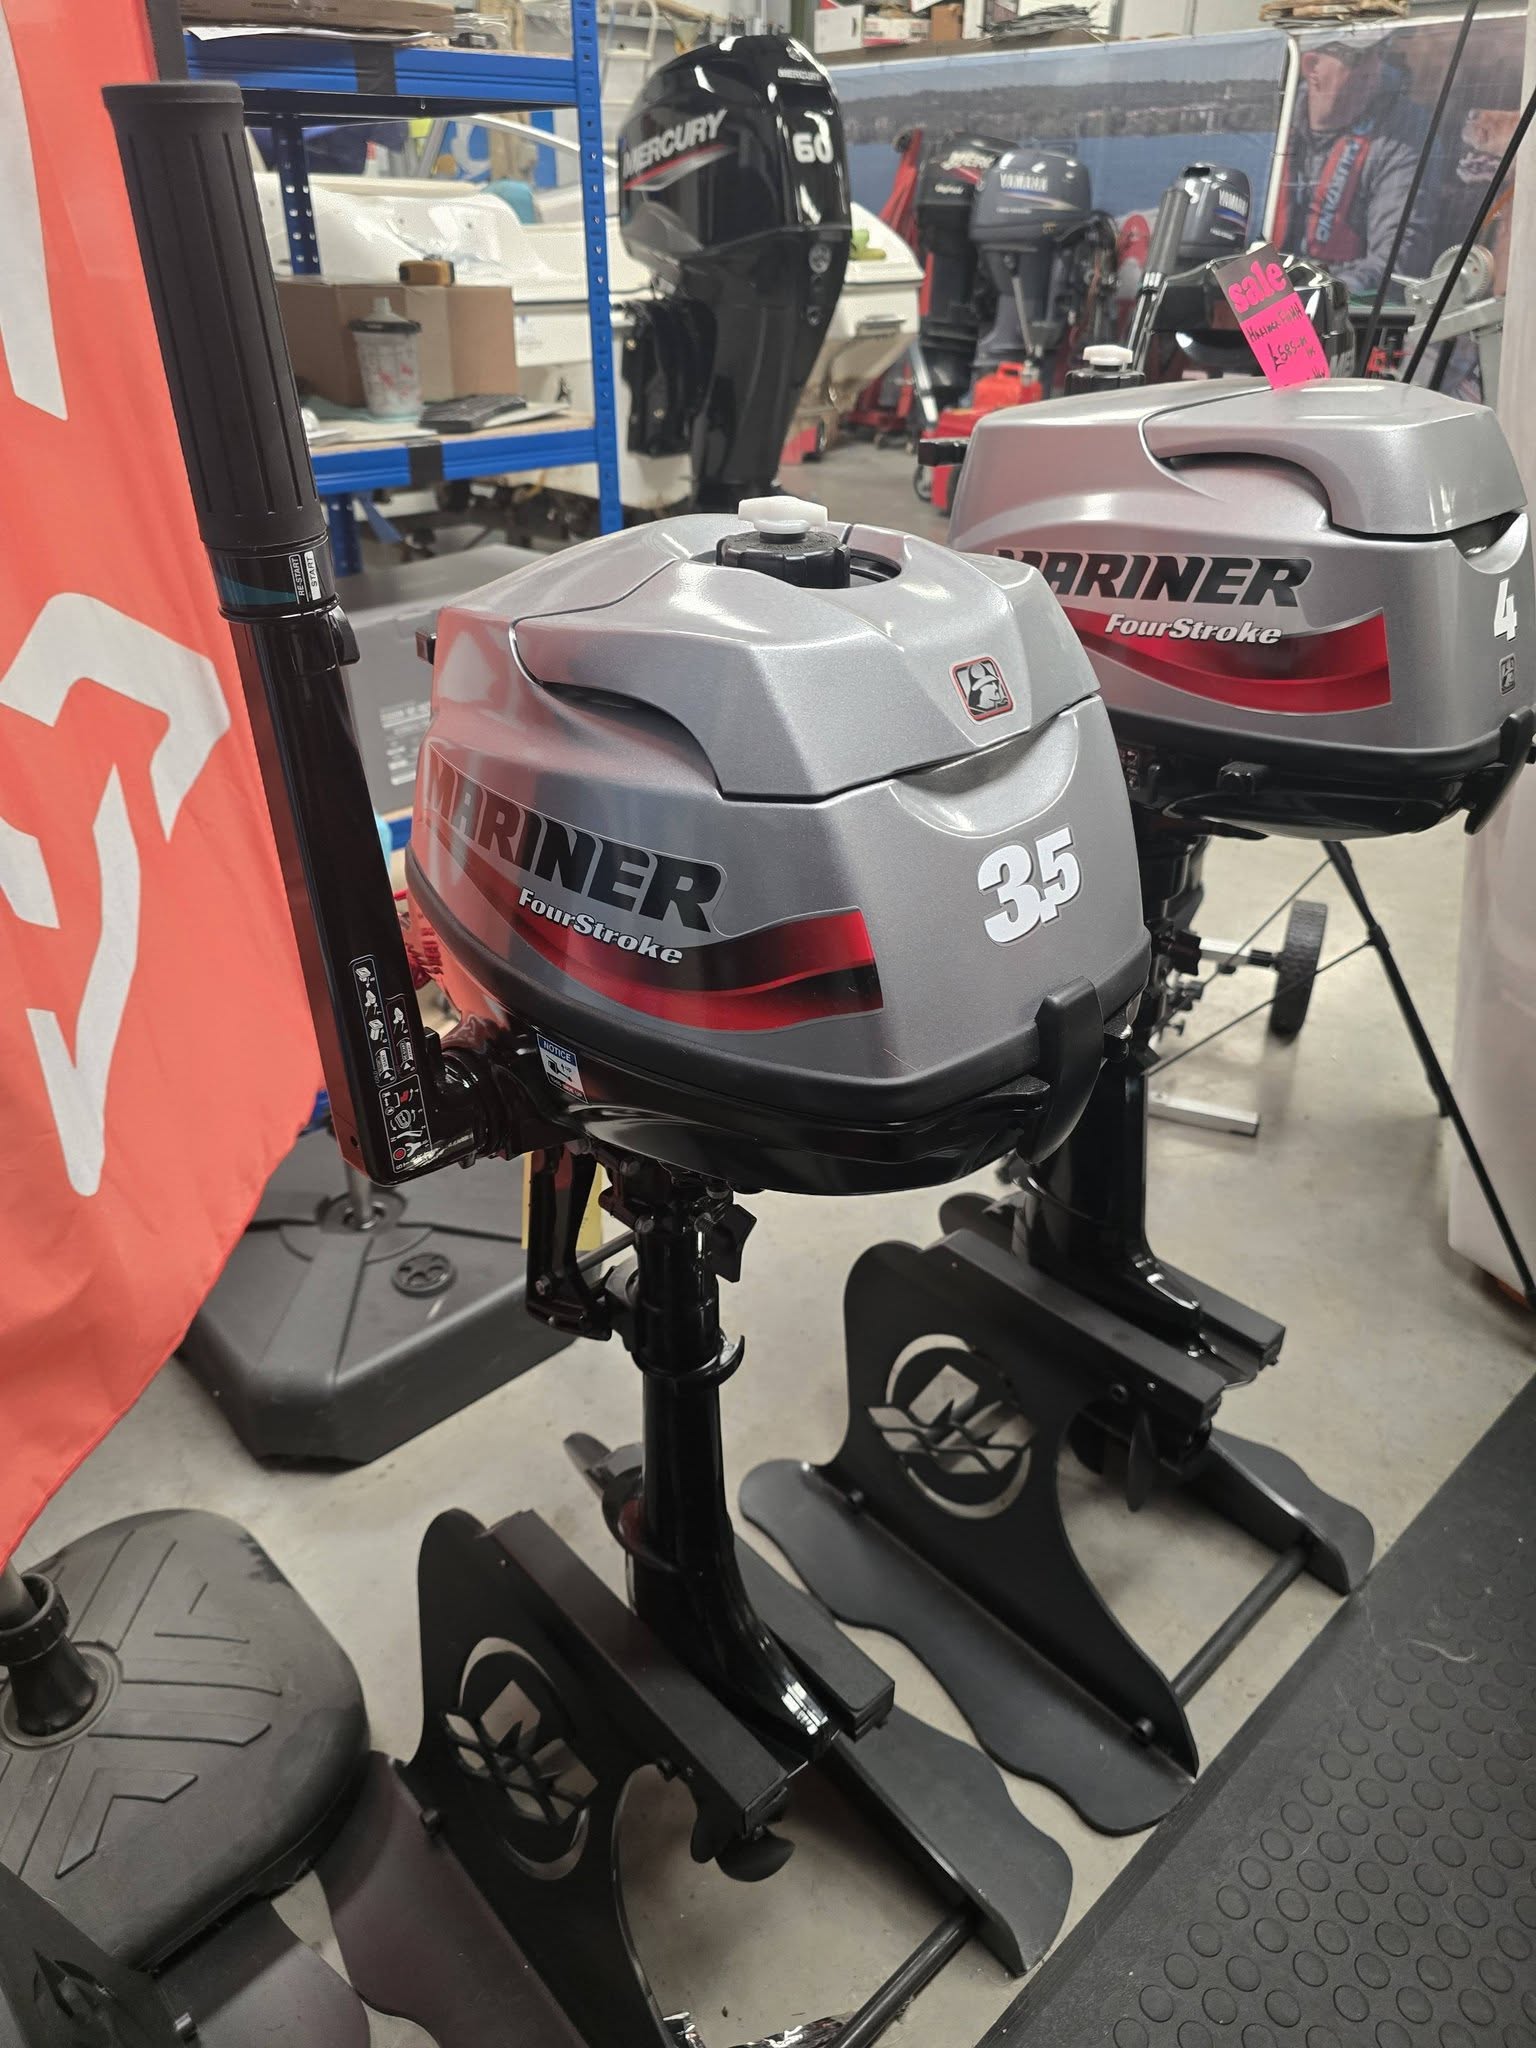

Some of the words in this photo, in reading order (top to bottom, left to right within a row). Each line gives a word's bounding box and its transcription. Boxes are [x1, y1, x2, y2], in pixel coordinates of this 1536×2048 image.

[622, 107, 728, 179] MERCURY
[792, 132, 834, 164] 60
[1000, 172, 1048, 193] YAMAHA
[1228, 260, 1286, 313] sale
[292, 558, 306, 596] RE-START
[1105, 614, 1282, 645] FourStroke
[1494, 578, 1517, 641] 4
[425, 757, 723, 933] MARINER
[518, 887, 684, 966] FourStroke
[543, 1040, 572, 1063] NOTICE
